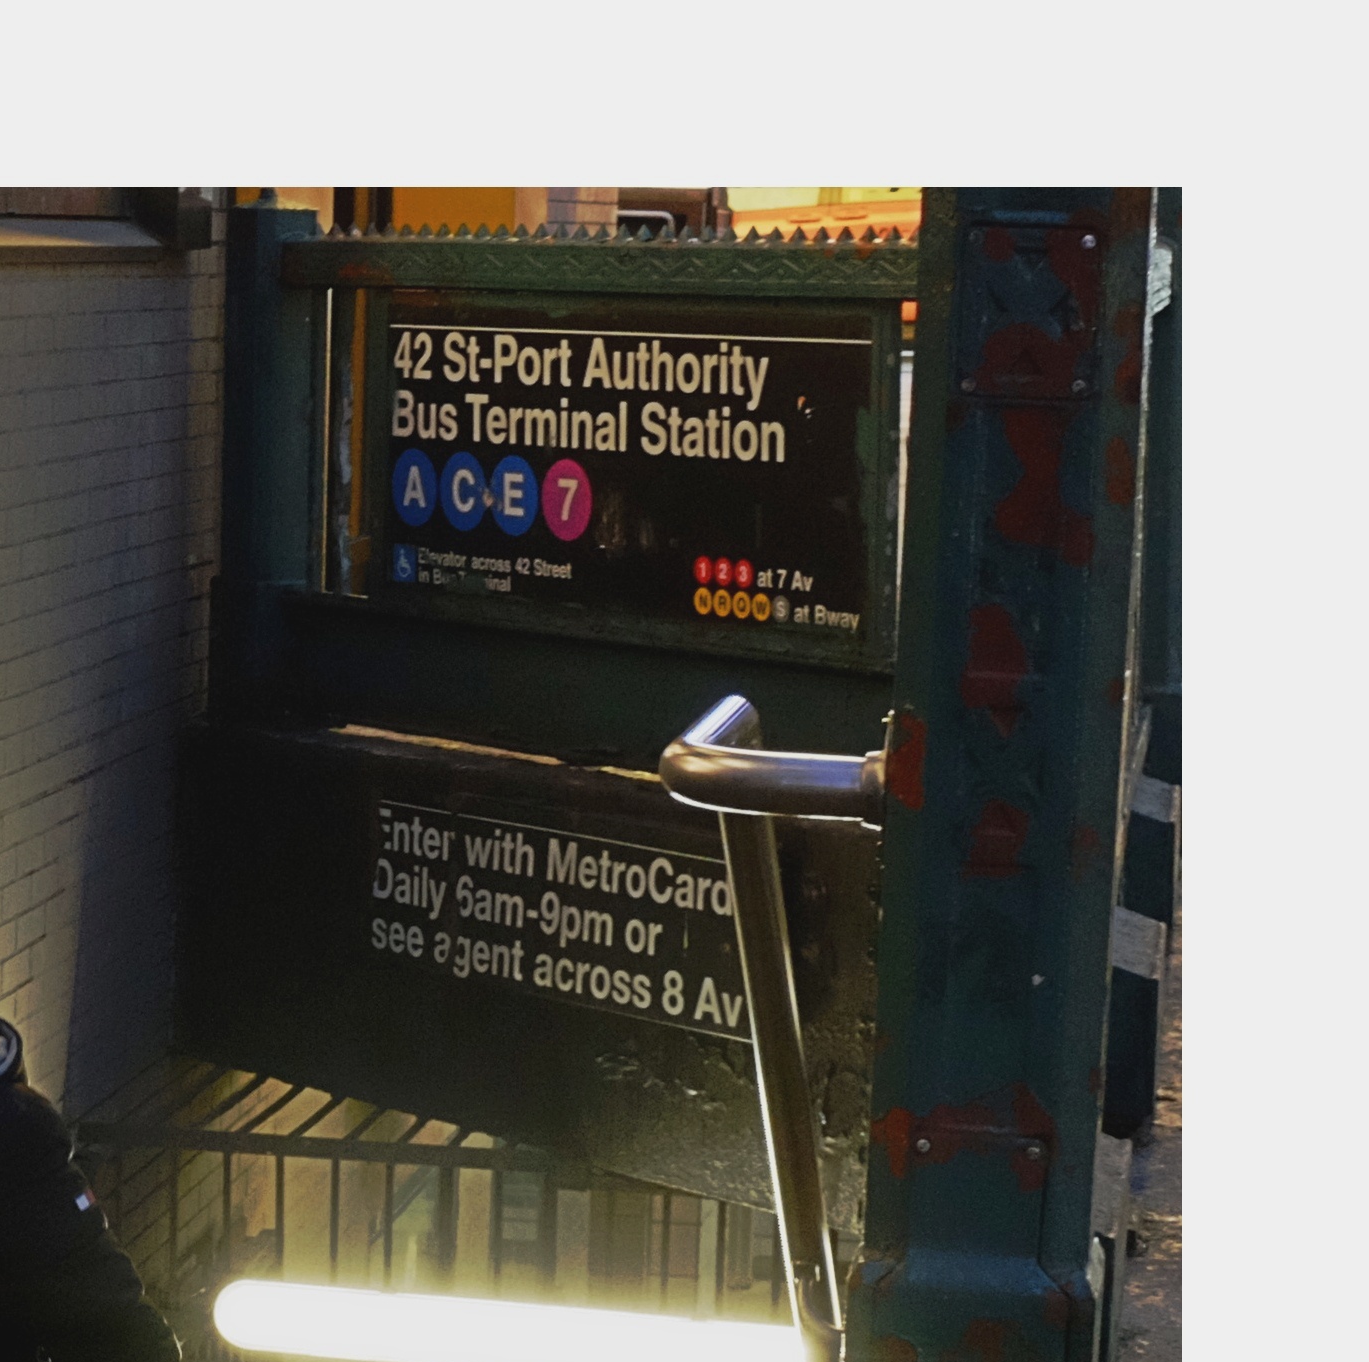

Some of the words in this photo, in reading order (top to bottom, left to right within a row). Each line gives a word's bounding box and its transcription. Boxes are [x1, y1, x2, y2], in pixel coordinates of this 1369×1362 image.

[393, 331, 433, 381] 42
[443, 332, 572, 387] St-Port
[582, 337, 769, 411] Authority
[391, 389, 458, 441] Bus
[465, 393, 627, 452] Terminal
[640, 401, 785, 463] Station
[403, 465, 427, 508] A
[451, 469, 475, 512] C
[503, 472, 525, 517] E
[557, 478, 579, 521] 7
[418, 566, 430, 584] in
[470, 556, 511, 573] across
[514, 557, 530, 575] 42
[533, 558, 572, 579] Street
[757, 568, 773, 588] at
[776, 569, 788, 590] 7
[791, 571, 814, 592] Av
[794, 605, 810, 624] at
[814, 604, 859, 633] Bway
[465, 829, 535, 877] with
[546, 837, 734, 916] MetroCard
[373, 858, 446, 920] Daily
[456, 875, 614, 948] 6am-9pm
[625, 918, 662, 956] or
[371, 917, 424, 957] see
[433, 931, 524, 978] agent
[533, 953, 652, 1009] across
[661, 969, 685, 1016] 8
[694, 976, 743, 1028] Av
